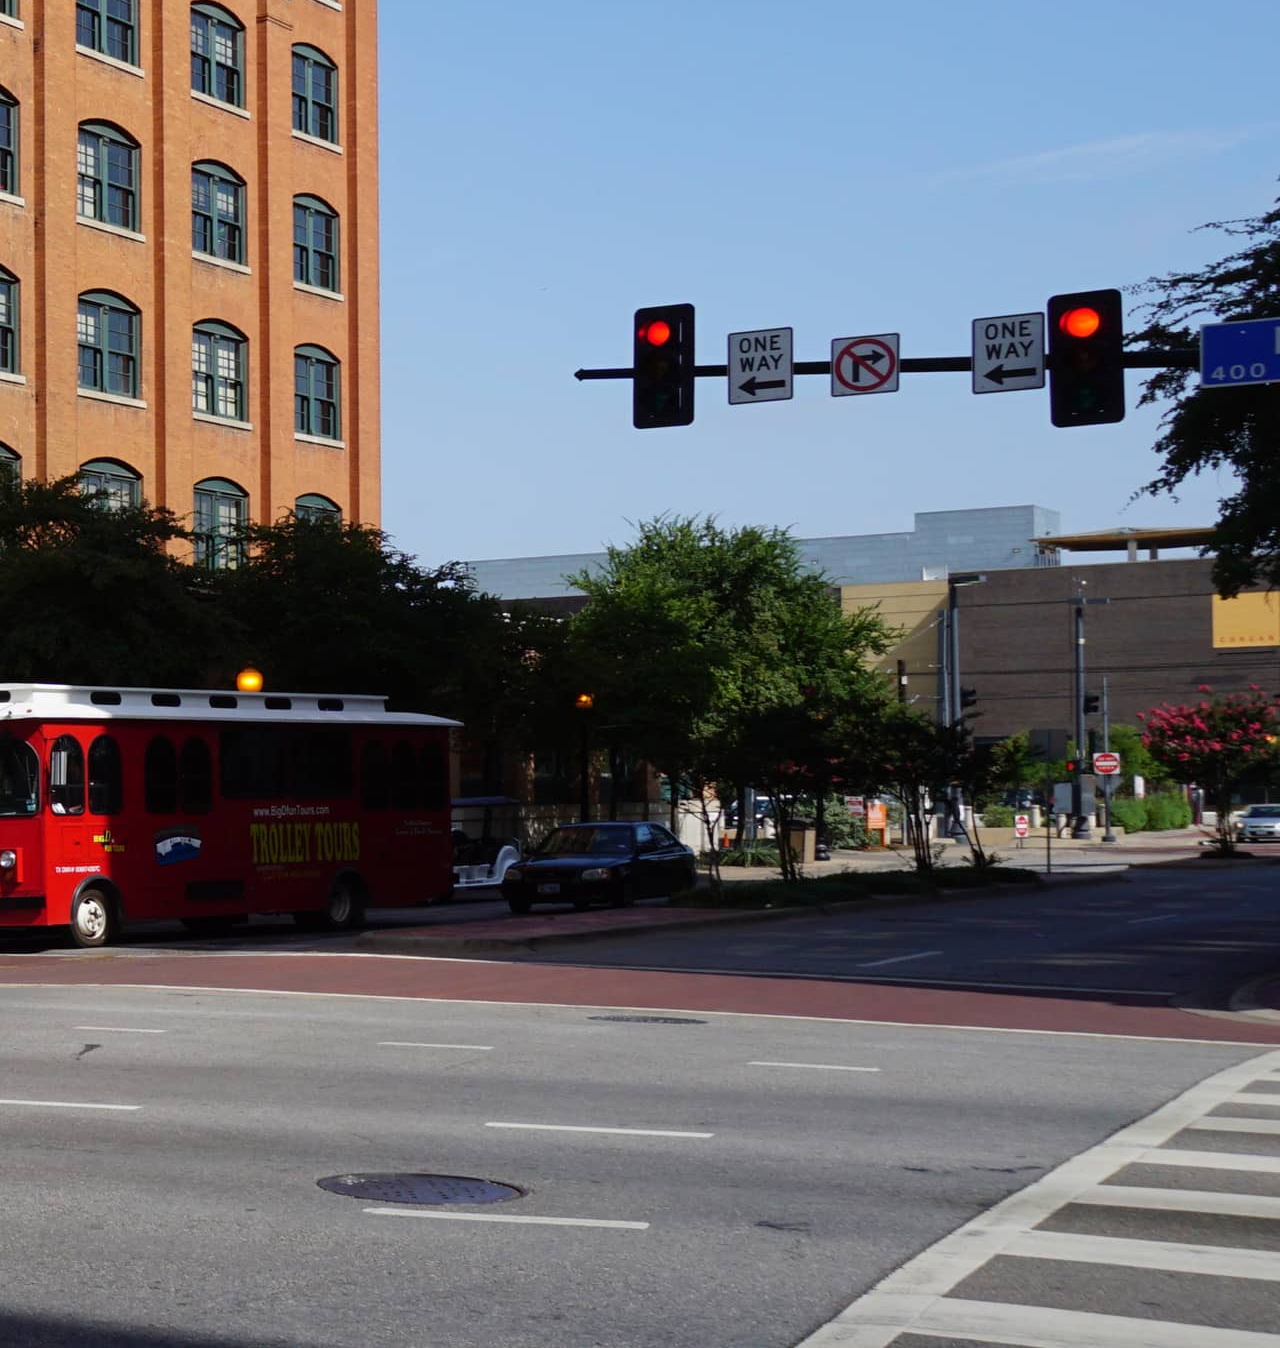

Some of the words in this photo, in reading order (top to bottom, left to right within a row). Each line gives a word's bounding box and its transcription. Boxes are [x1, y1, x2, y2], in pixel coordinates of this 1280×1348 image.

[985, 320, 1032, 340] ONE
[739, 334, 781, 354] ONE
[985, 340, 1034, 360] WAY
[740, 354, 784, 373] WAY
[1211, 363, 1266, 380] 400
[250, 823, 311, 864] TROLLEY
[314, 822, 360, 861] TOURS
